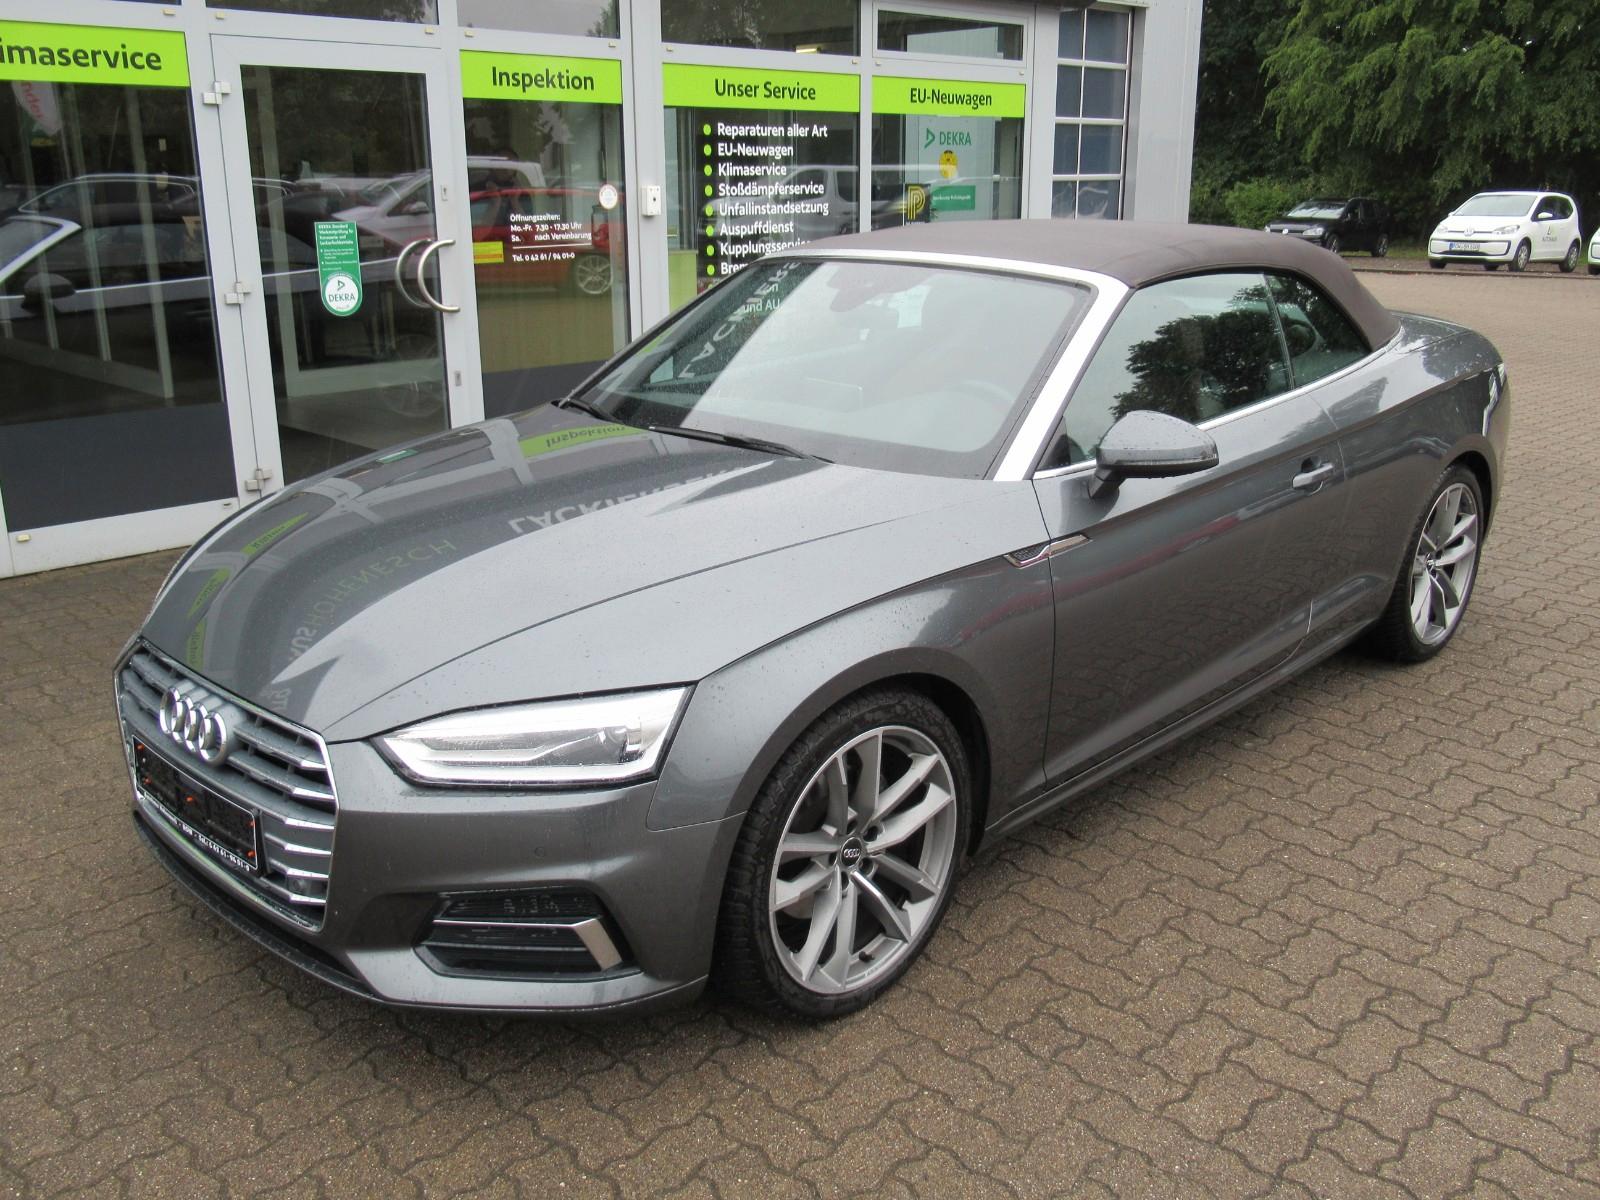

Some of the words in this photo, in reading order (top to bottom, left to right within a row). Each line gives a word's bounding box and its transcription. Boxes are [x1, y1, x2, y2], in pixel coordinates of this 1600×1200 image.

[492, 66, 594, 93] Inspektion
[715, 79, 760, 98] Unser
[764, 80, 816, 100] Service
[910, 87, 993, 110] EU-Neuwagen
[717, 122, 785, 139] Reparaturen
[787, 123, 809, 137] aller
[811, 124, 828, 137] Art
[939, 131, 972, 146] DEKRA
[718, 142, 794, 159] EU-Neuwagen
[718, 162, 787, 176] Klimaservice
[718, 181, 825, 199] Stoßdämpferservice
[719, 201, 829, 216] Unfallinstandsetzung
[510, 213, 560, 222] Öffnungszeiten:
[570, 222, 582, 230] Uhr
[551, 232, 592, 240] Vereinbarung
[719, 220, 794, 238] Auspuffdienst
[720, 237, 810, 258] Kupplungsservi
[328, 293, 356, 302] DEKRA
